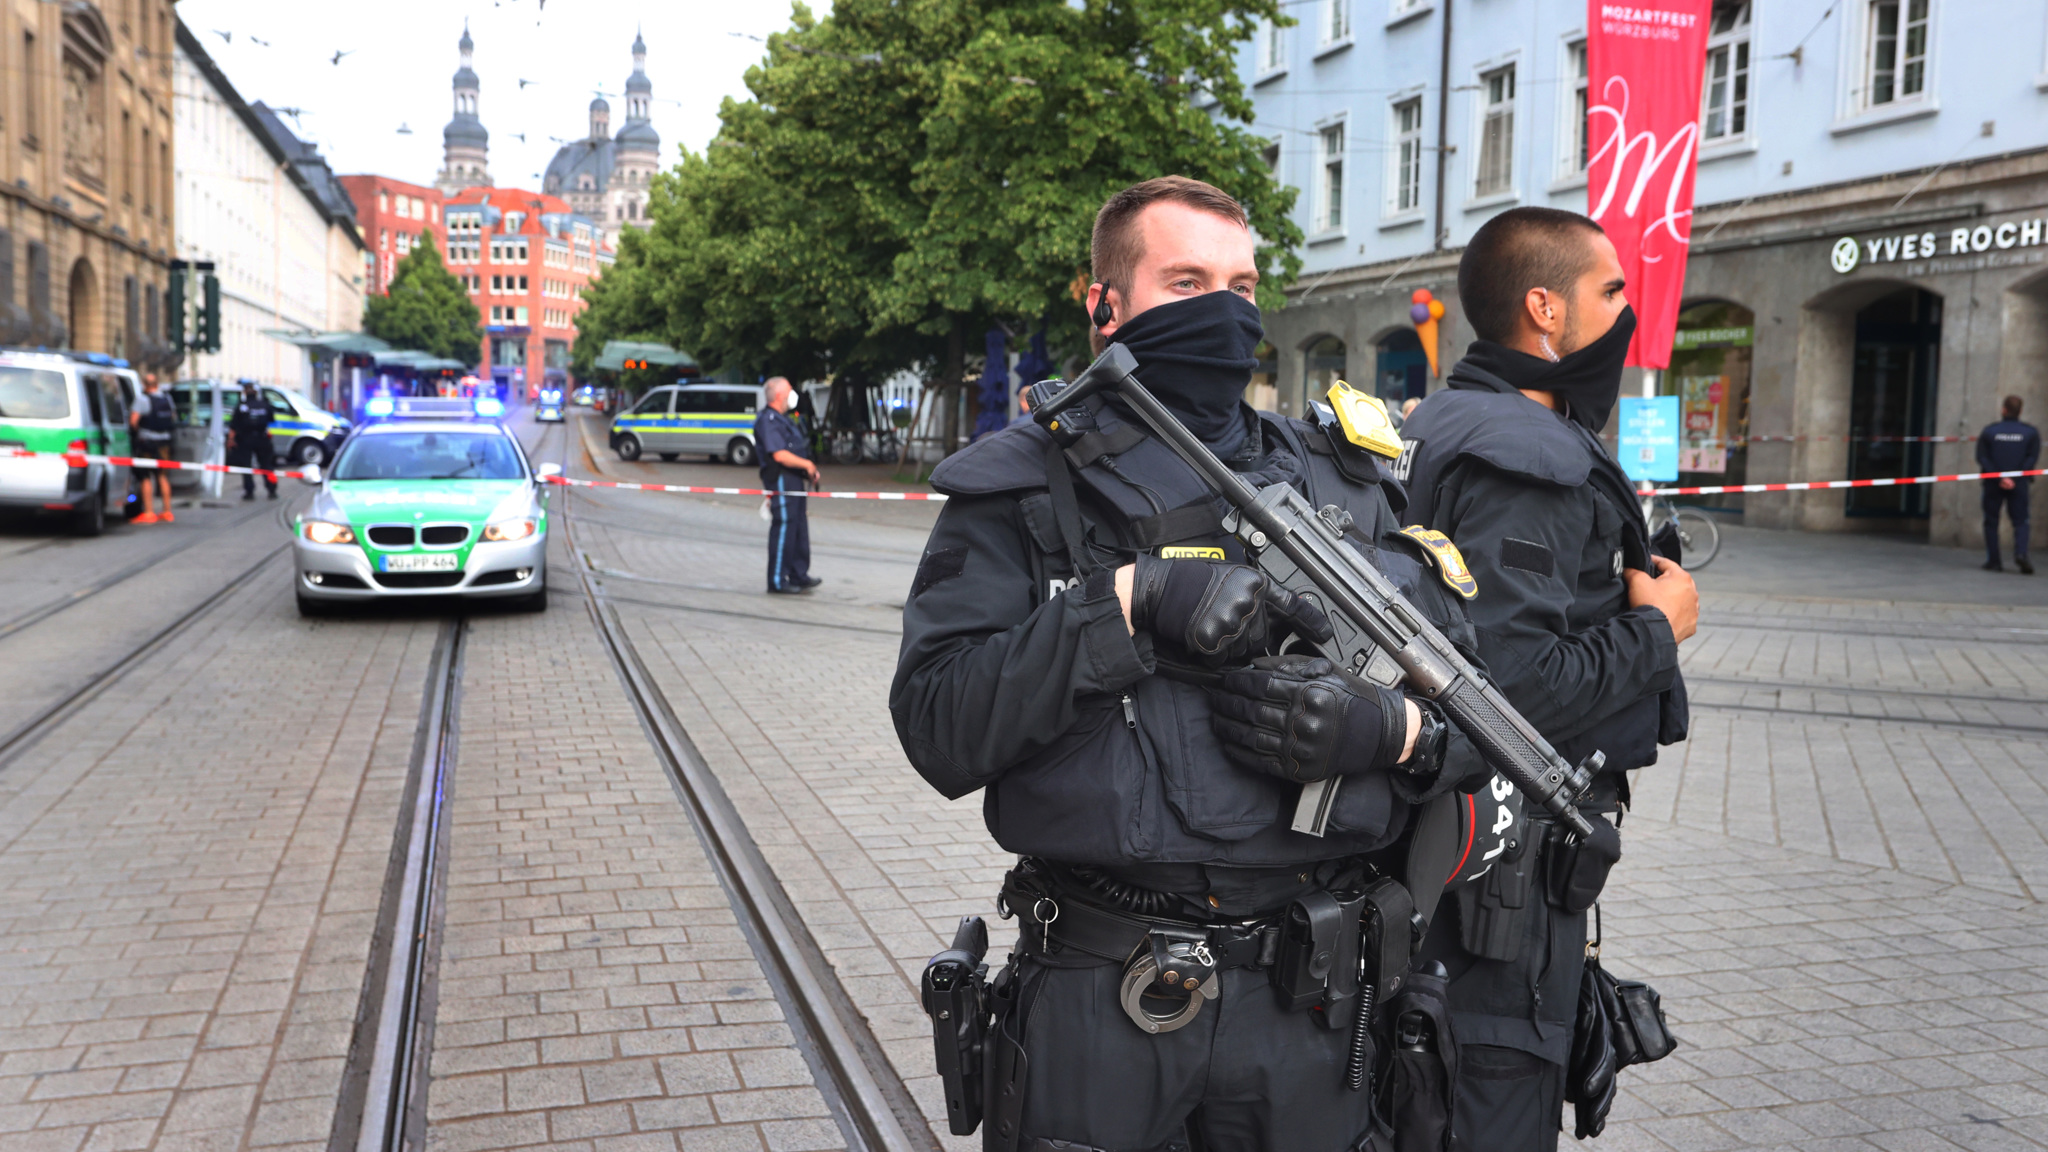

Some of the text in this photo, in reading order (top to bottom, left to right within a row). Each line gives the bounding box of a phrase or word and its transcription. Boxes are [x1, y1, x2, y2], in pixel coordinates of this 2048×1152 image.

[1602, 5, 1696, 28] MOZARTFEST
[1866, 232, 1937, 264] YVES
[1950, 218, 2048, 255] ROCH
